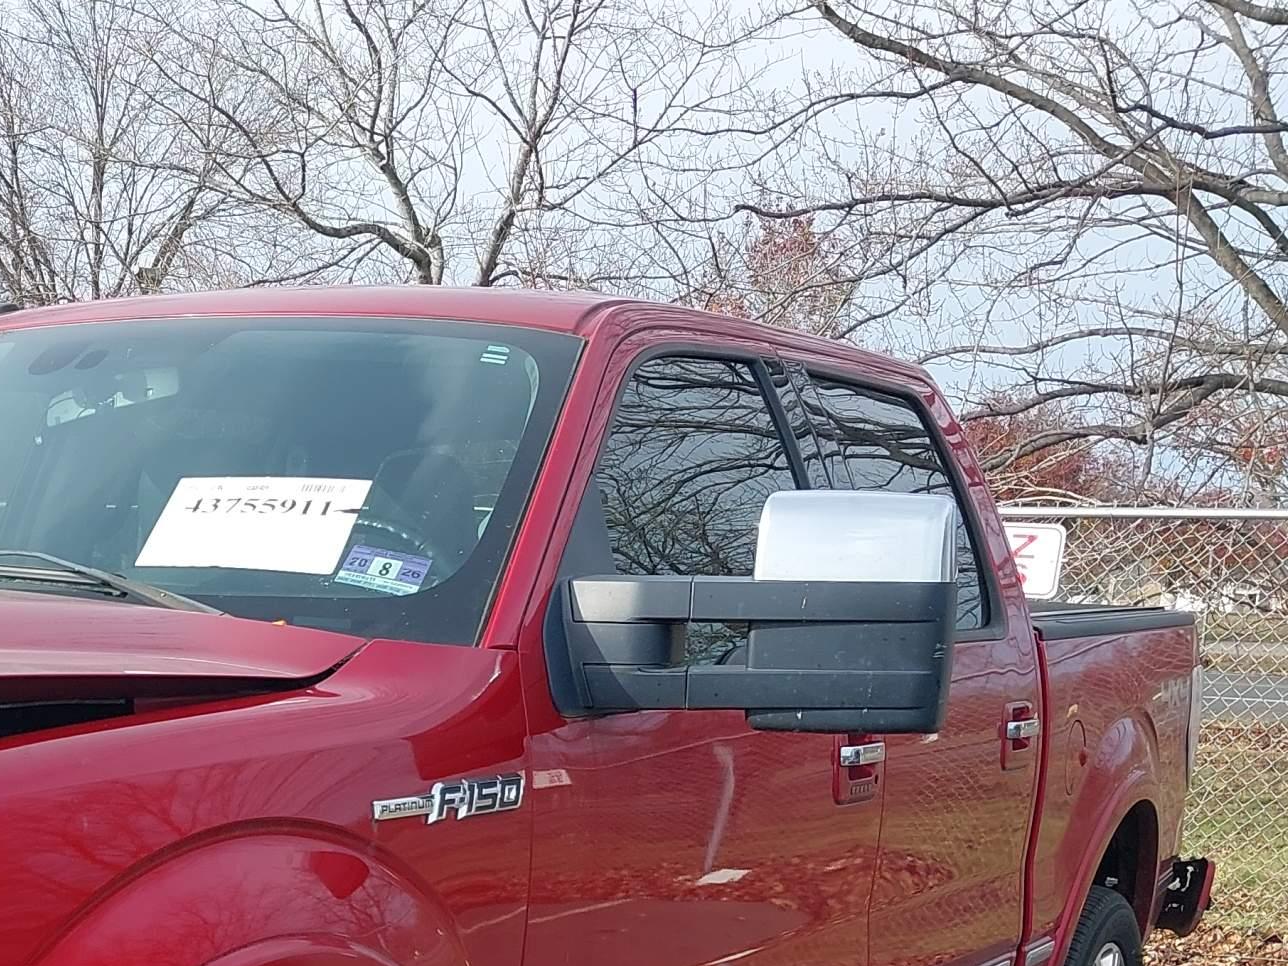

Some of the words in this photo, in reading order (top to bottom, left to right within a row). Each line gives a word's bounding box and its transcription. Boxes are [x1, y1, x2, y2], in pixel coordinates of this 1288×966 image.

[185, 497, 332, 516] 43755911
[349, 556, 369, 569] 20
[378, 561, 393, 577] 8
[400, 567, 422, 580] 26
[379, 797, 434, 816] PLATINUM
